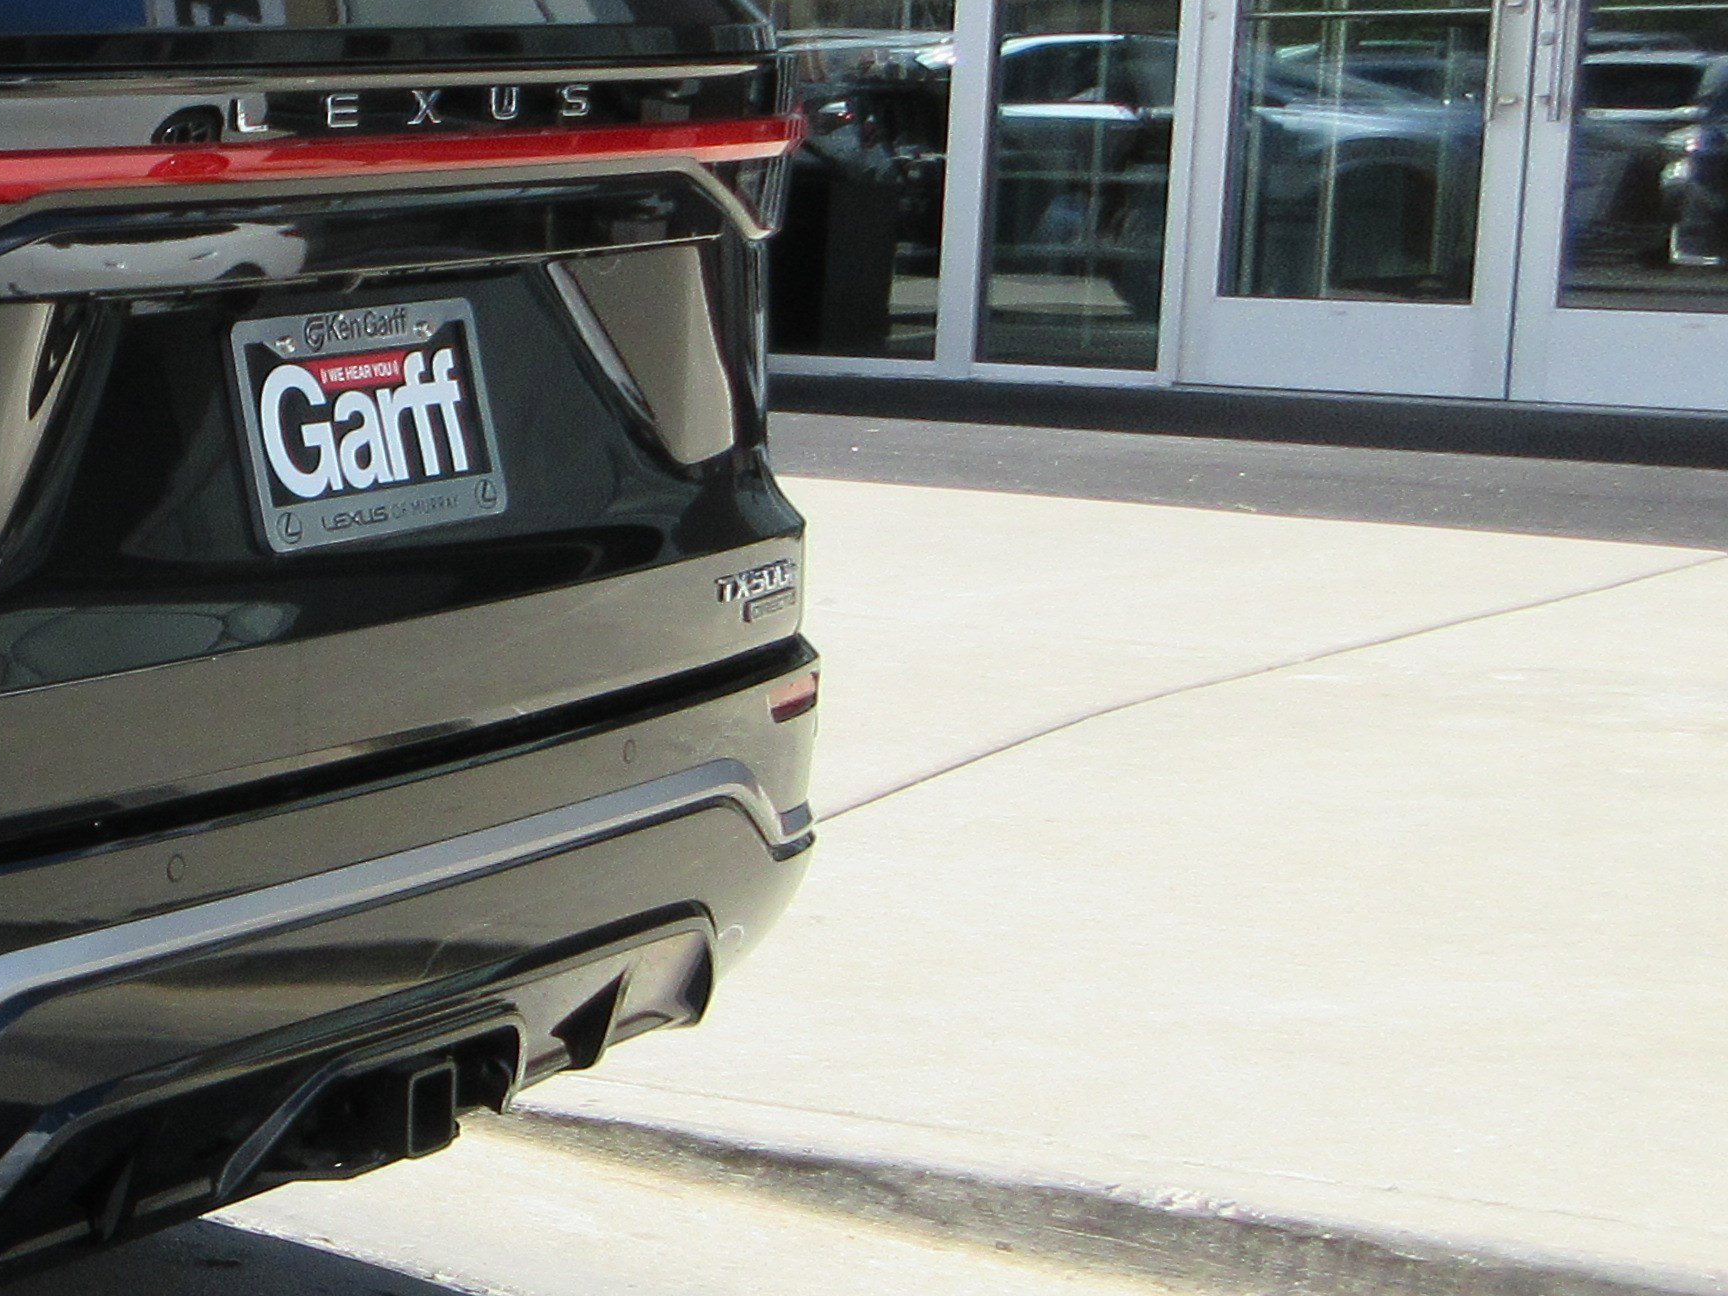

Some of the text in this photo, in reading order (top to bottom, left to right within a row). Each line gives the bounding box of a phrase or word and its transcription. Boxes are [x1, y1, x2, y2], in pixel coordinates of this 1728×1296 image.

[234, 83, 591, 134] LEXUS
[325, 307, 407, 342] Ken Garff
[328, 361, 393, 382] WE HEAR YOU
[260, 348, 469, 498] Garff
[321, 505, 390, 532] LEXUS
